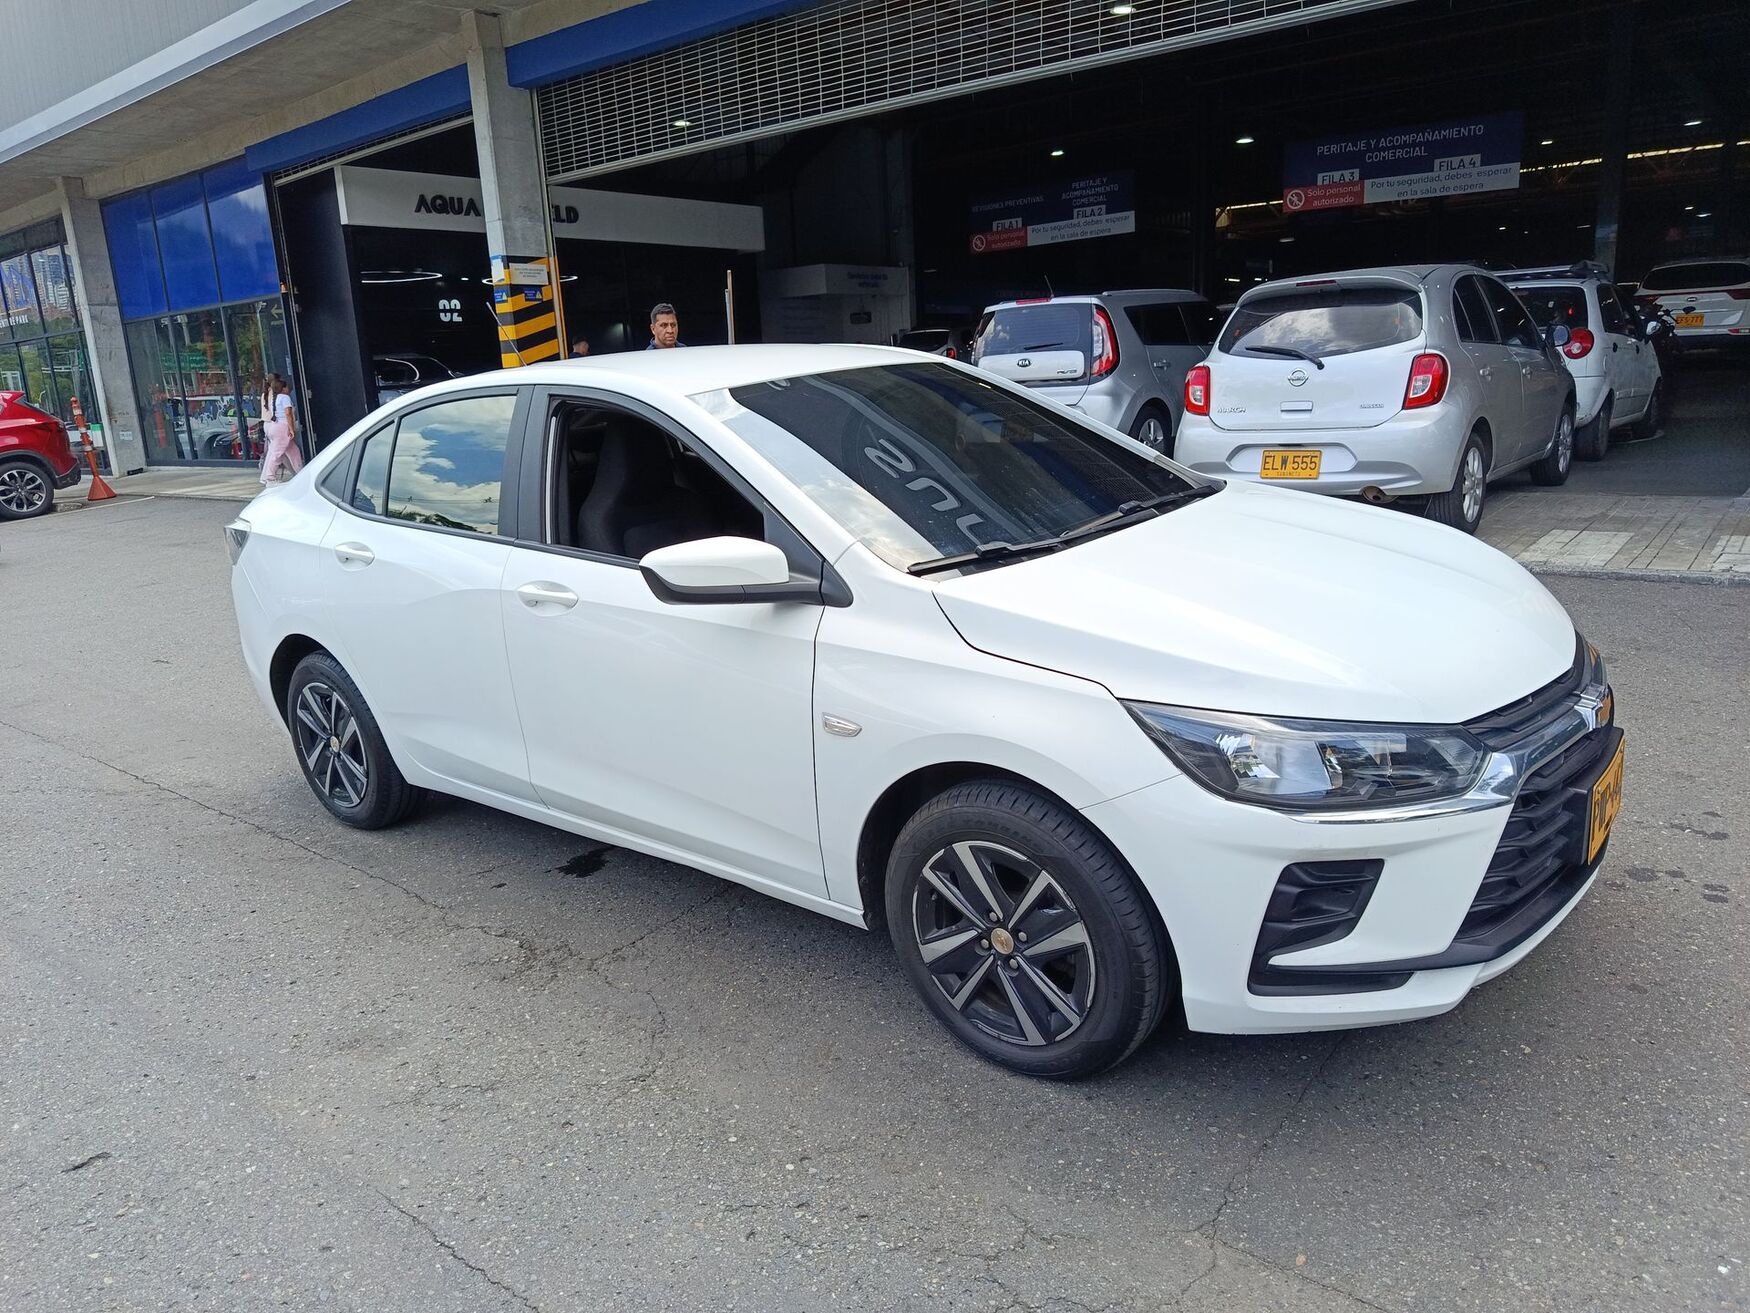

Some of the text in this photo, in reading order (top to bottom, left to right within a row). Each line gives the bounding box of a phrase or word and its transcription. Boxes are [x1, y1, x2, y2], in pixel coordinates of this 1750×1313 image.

[1317, 124, 1484, 156] PERITAJE Y ACOMPAÑAMIENTO
[1365, 145, 1428, 162] COMERCIAL
[1439, 157, 1476, 172] FILA 4
[1321, 171, 1355, 185] FILA 3
[1371, 166, 1512, 189] Por tu seguridad, debes esperar
[1307, 184, 1361, 197] Solo personal
[1397, 182, 1484, 198] en la sala de espera
[415, 194, 482, 217] AQUA
[1076, 208, 1096, 220] FILA
[1018, 359, 1031, 367] KIA
[1263, 454, 1319, 471] ELW 555
